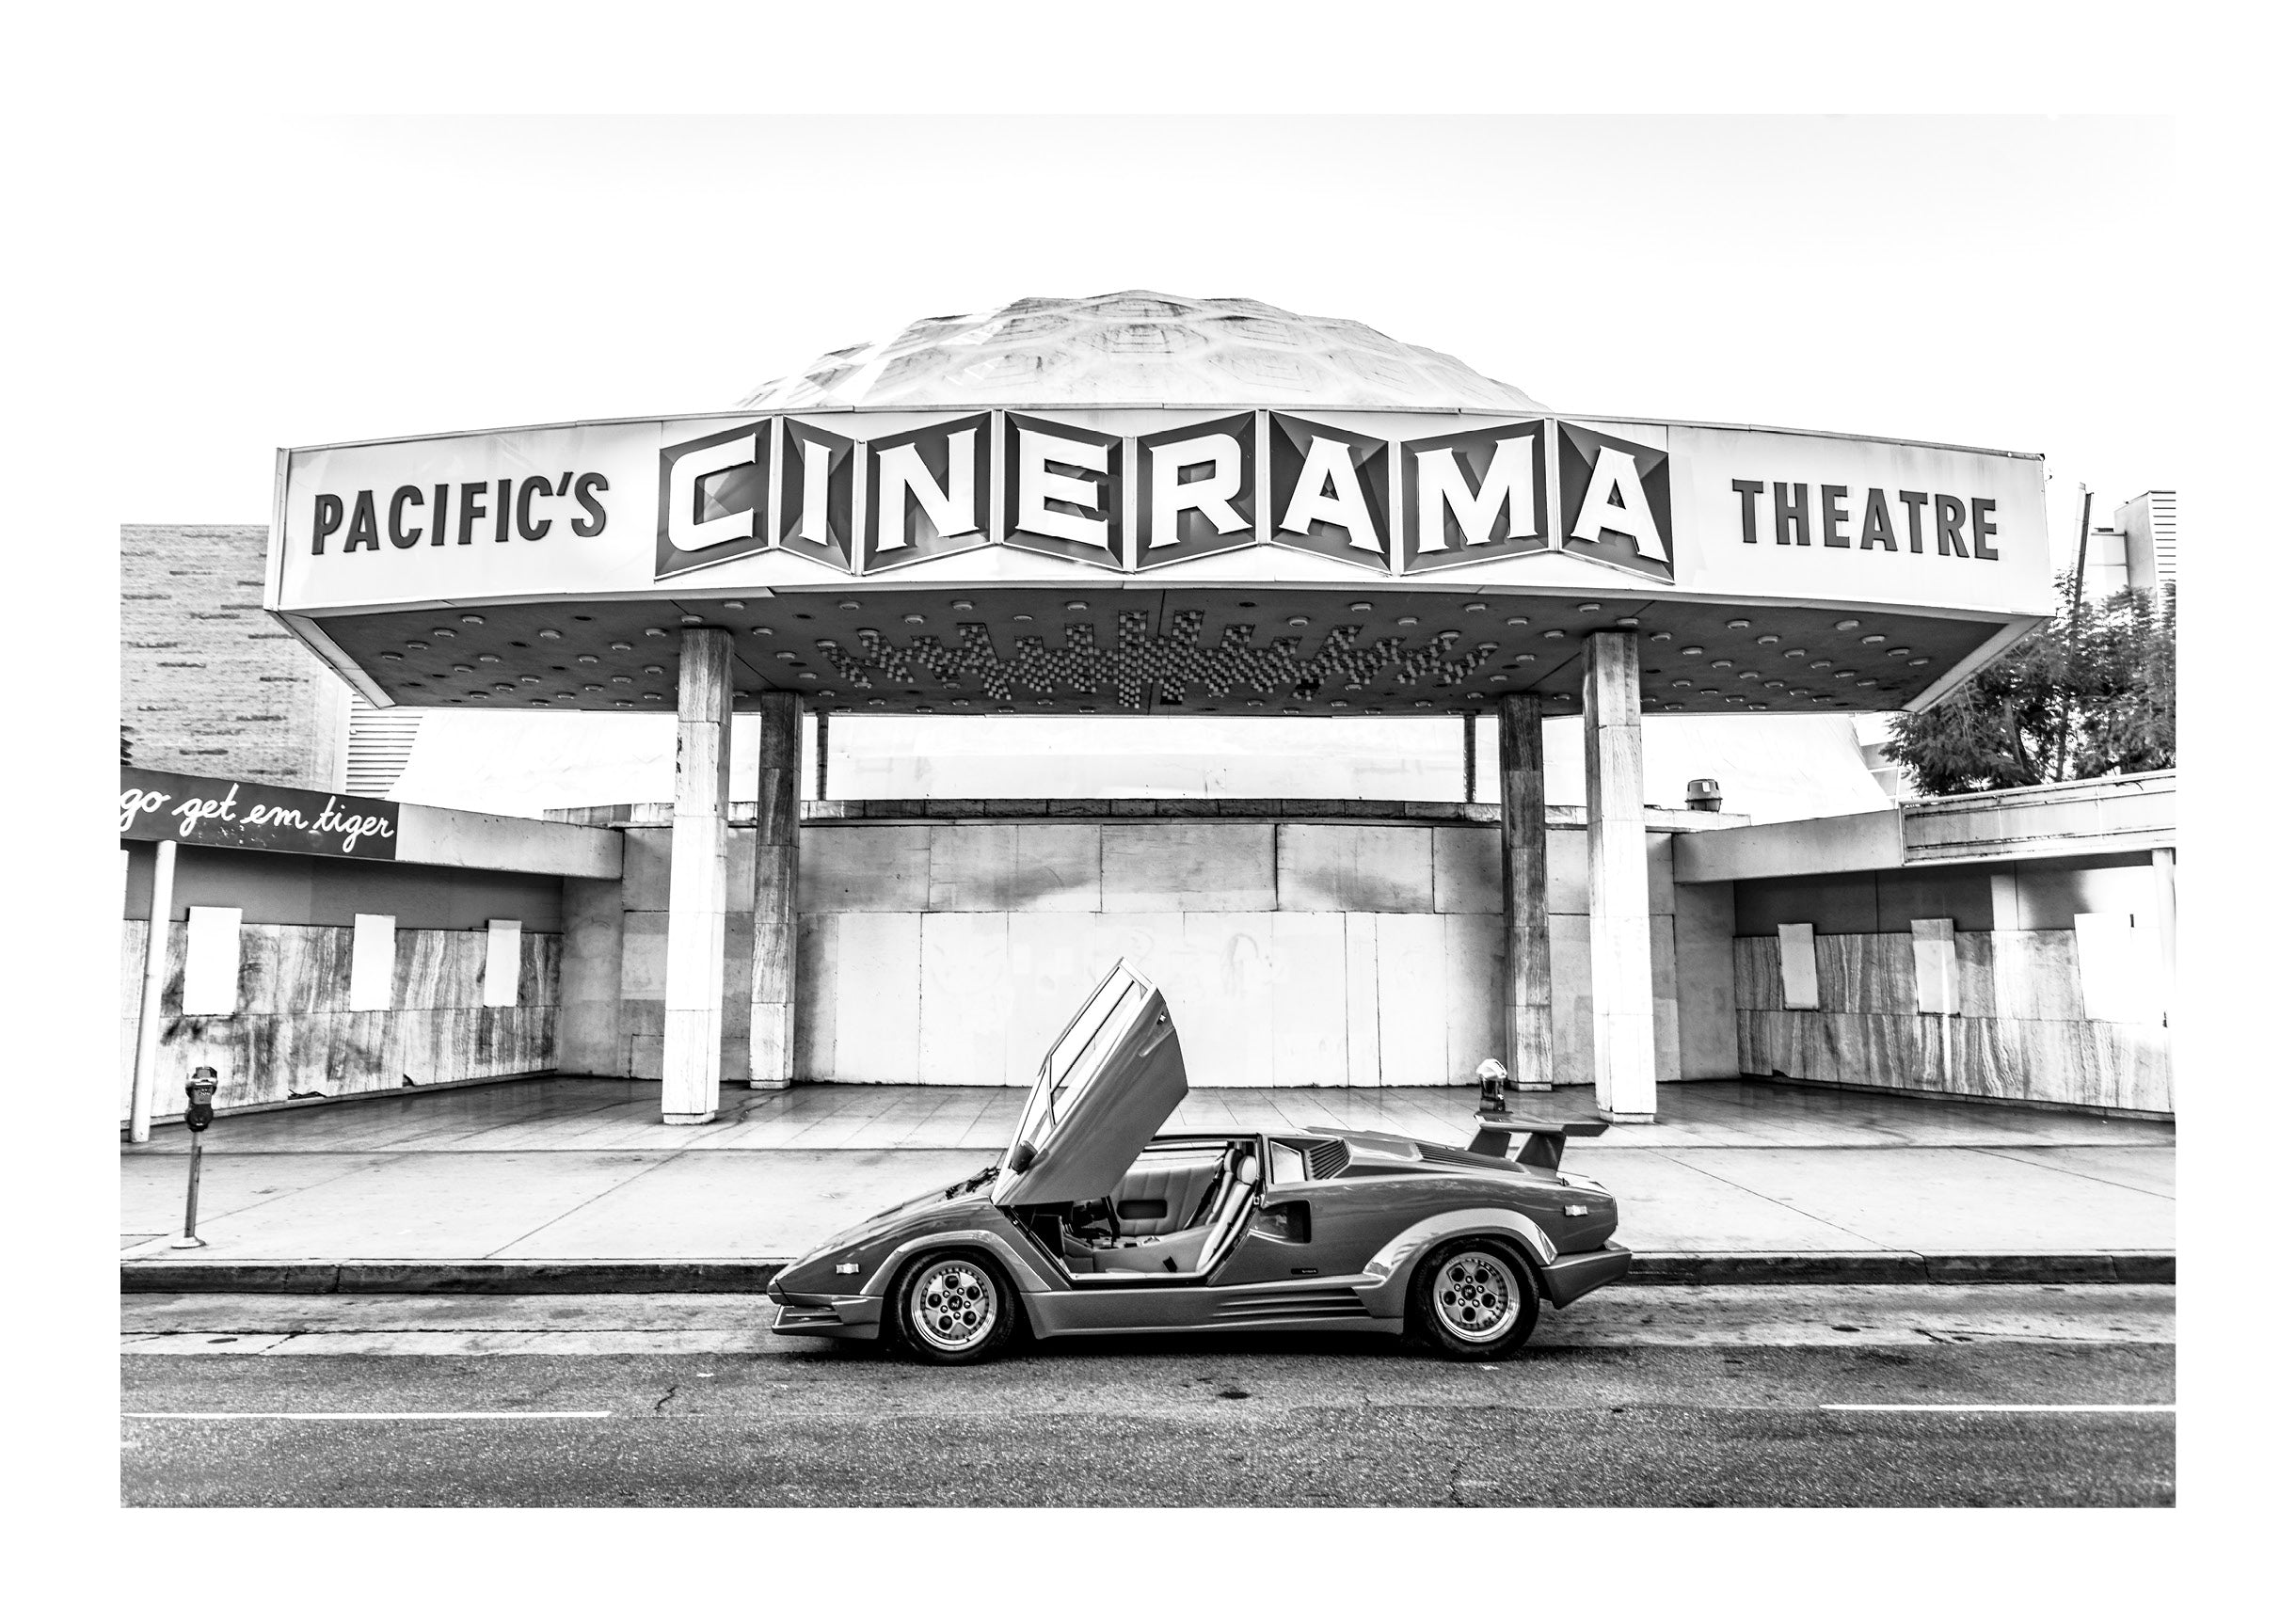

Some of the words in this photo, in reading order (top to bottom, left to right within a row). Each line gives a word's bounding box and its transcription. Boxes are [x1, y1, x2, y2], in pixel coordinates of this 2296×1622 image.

[311, 471, 610, 555] PACIFIC'S
[668, 426, 1670, 564] CINERAMA
[1731, 478, 1999, 561] THEATRE
[120, 787, 171, 833] go
[171, 782, 238, 837] get
[240, 803, 310, 830] em
[311, 795, 395, 853] tiger
